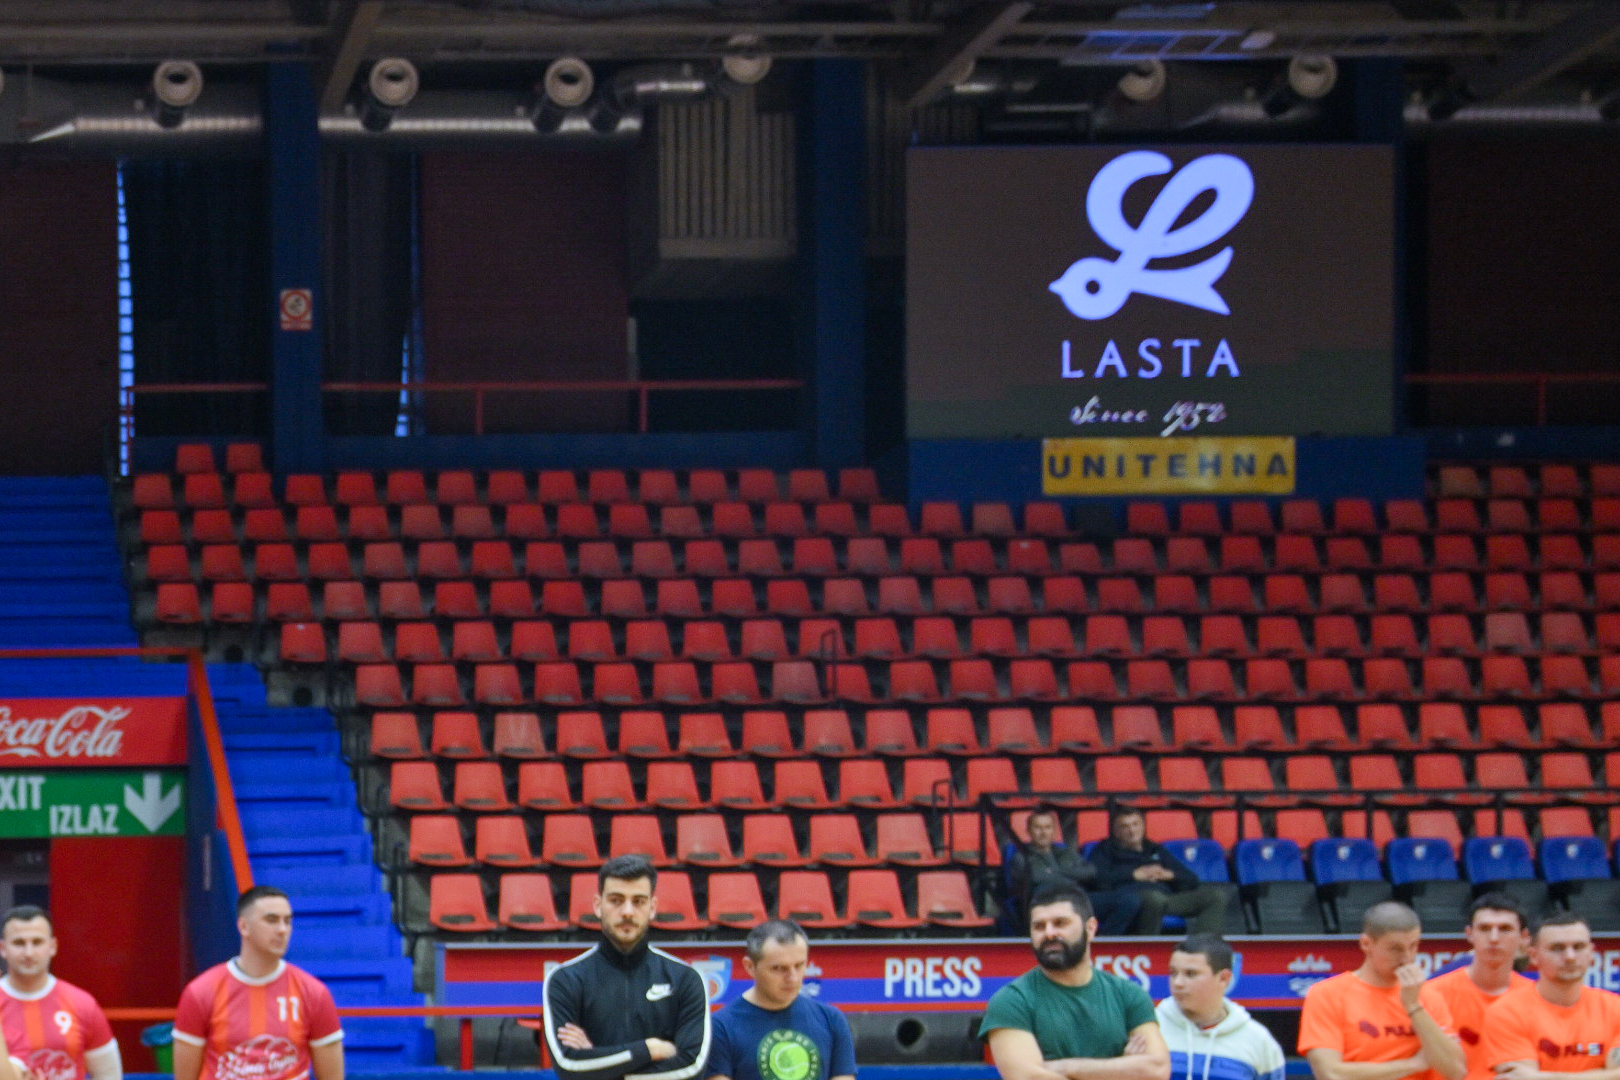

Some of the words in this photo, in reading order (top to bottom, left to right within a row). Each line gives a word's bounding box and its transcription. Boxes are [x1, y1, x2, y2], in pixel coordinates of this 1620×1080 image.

[1061, 339, 1240, 379] LASTA
[1049, 455, 1289, 478] UNITEHNA
[49, 803, 121, 835] IZLAZ
[884, 956, 983, 998] PRESS
[53, 1010, 73, 1035] 9
[276, 996, 300, 1022] 11
